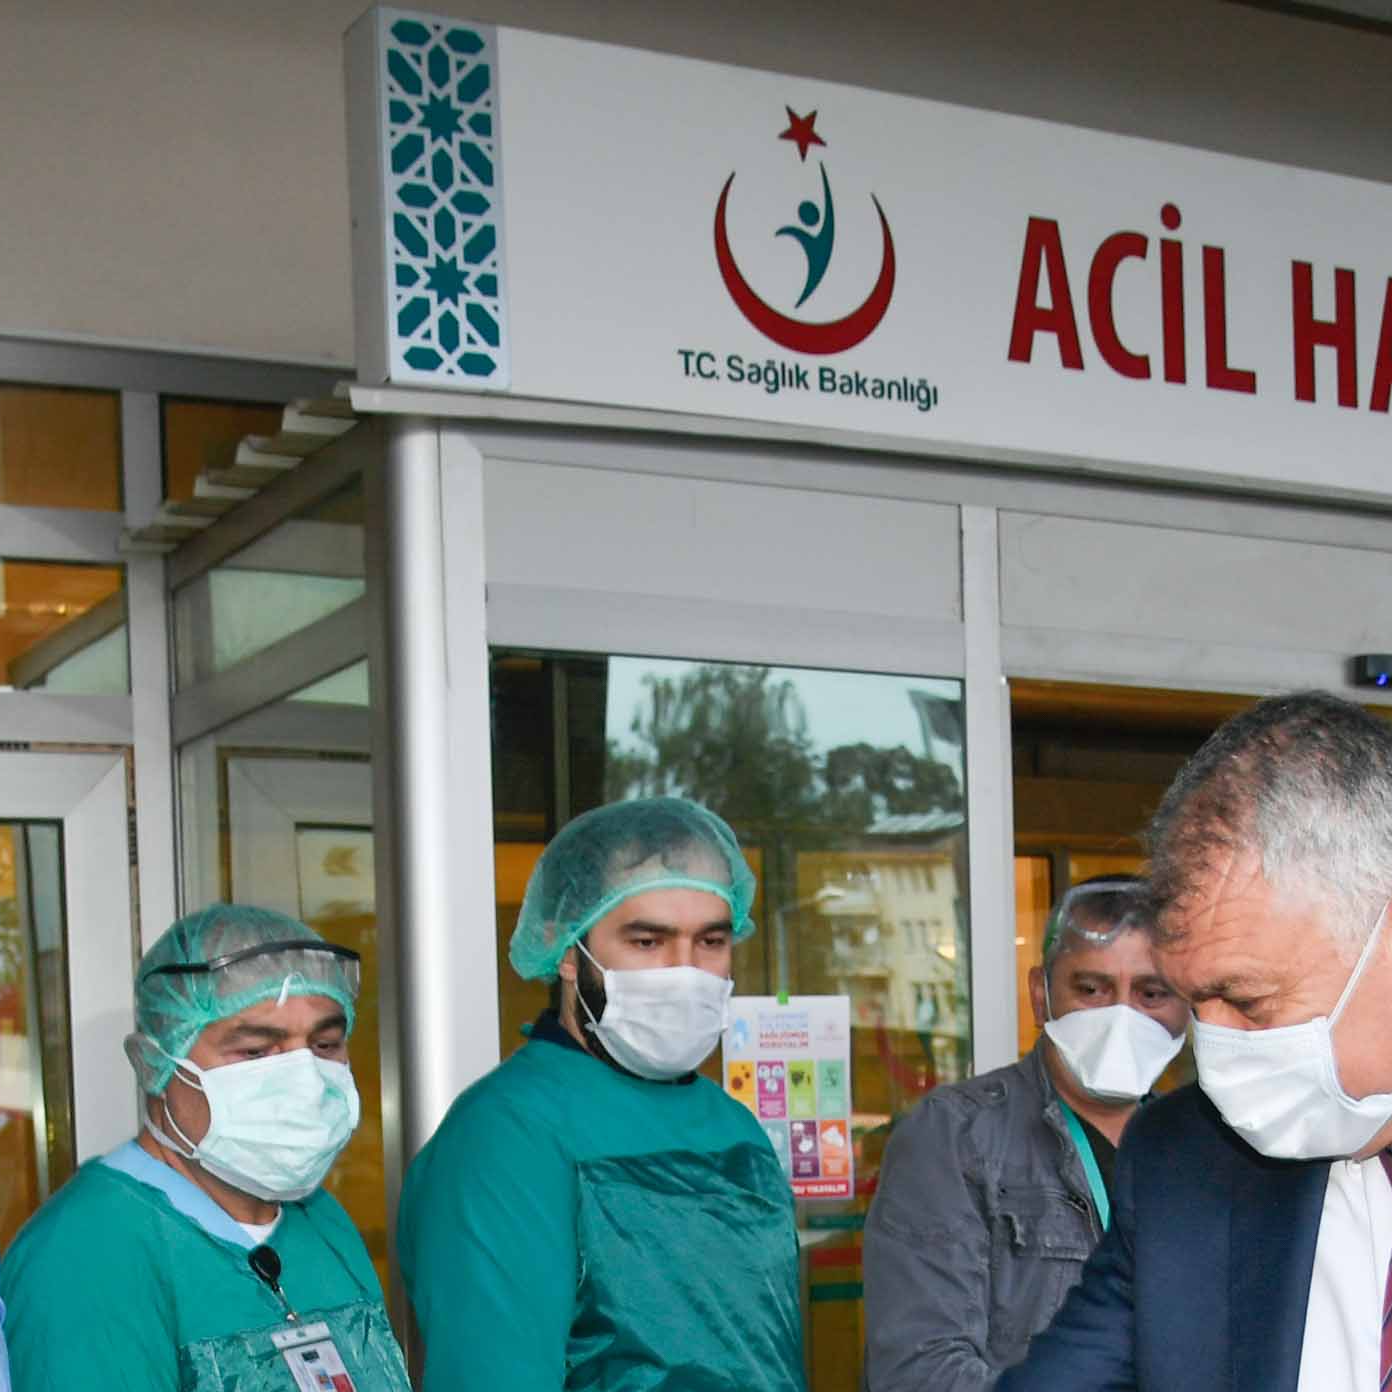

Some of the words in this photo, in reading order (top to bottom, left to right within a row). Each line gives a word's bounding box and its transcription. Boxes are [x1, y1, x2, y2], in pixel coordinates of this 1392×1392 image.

[1007, 203, 1257, 395] ACİL
[677, 349, 720, 381] T.C.
[726, 354, 810, 394] Sağlık
[819, 367, 939, 412] Bakanlığı
